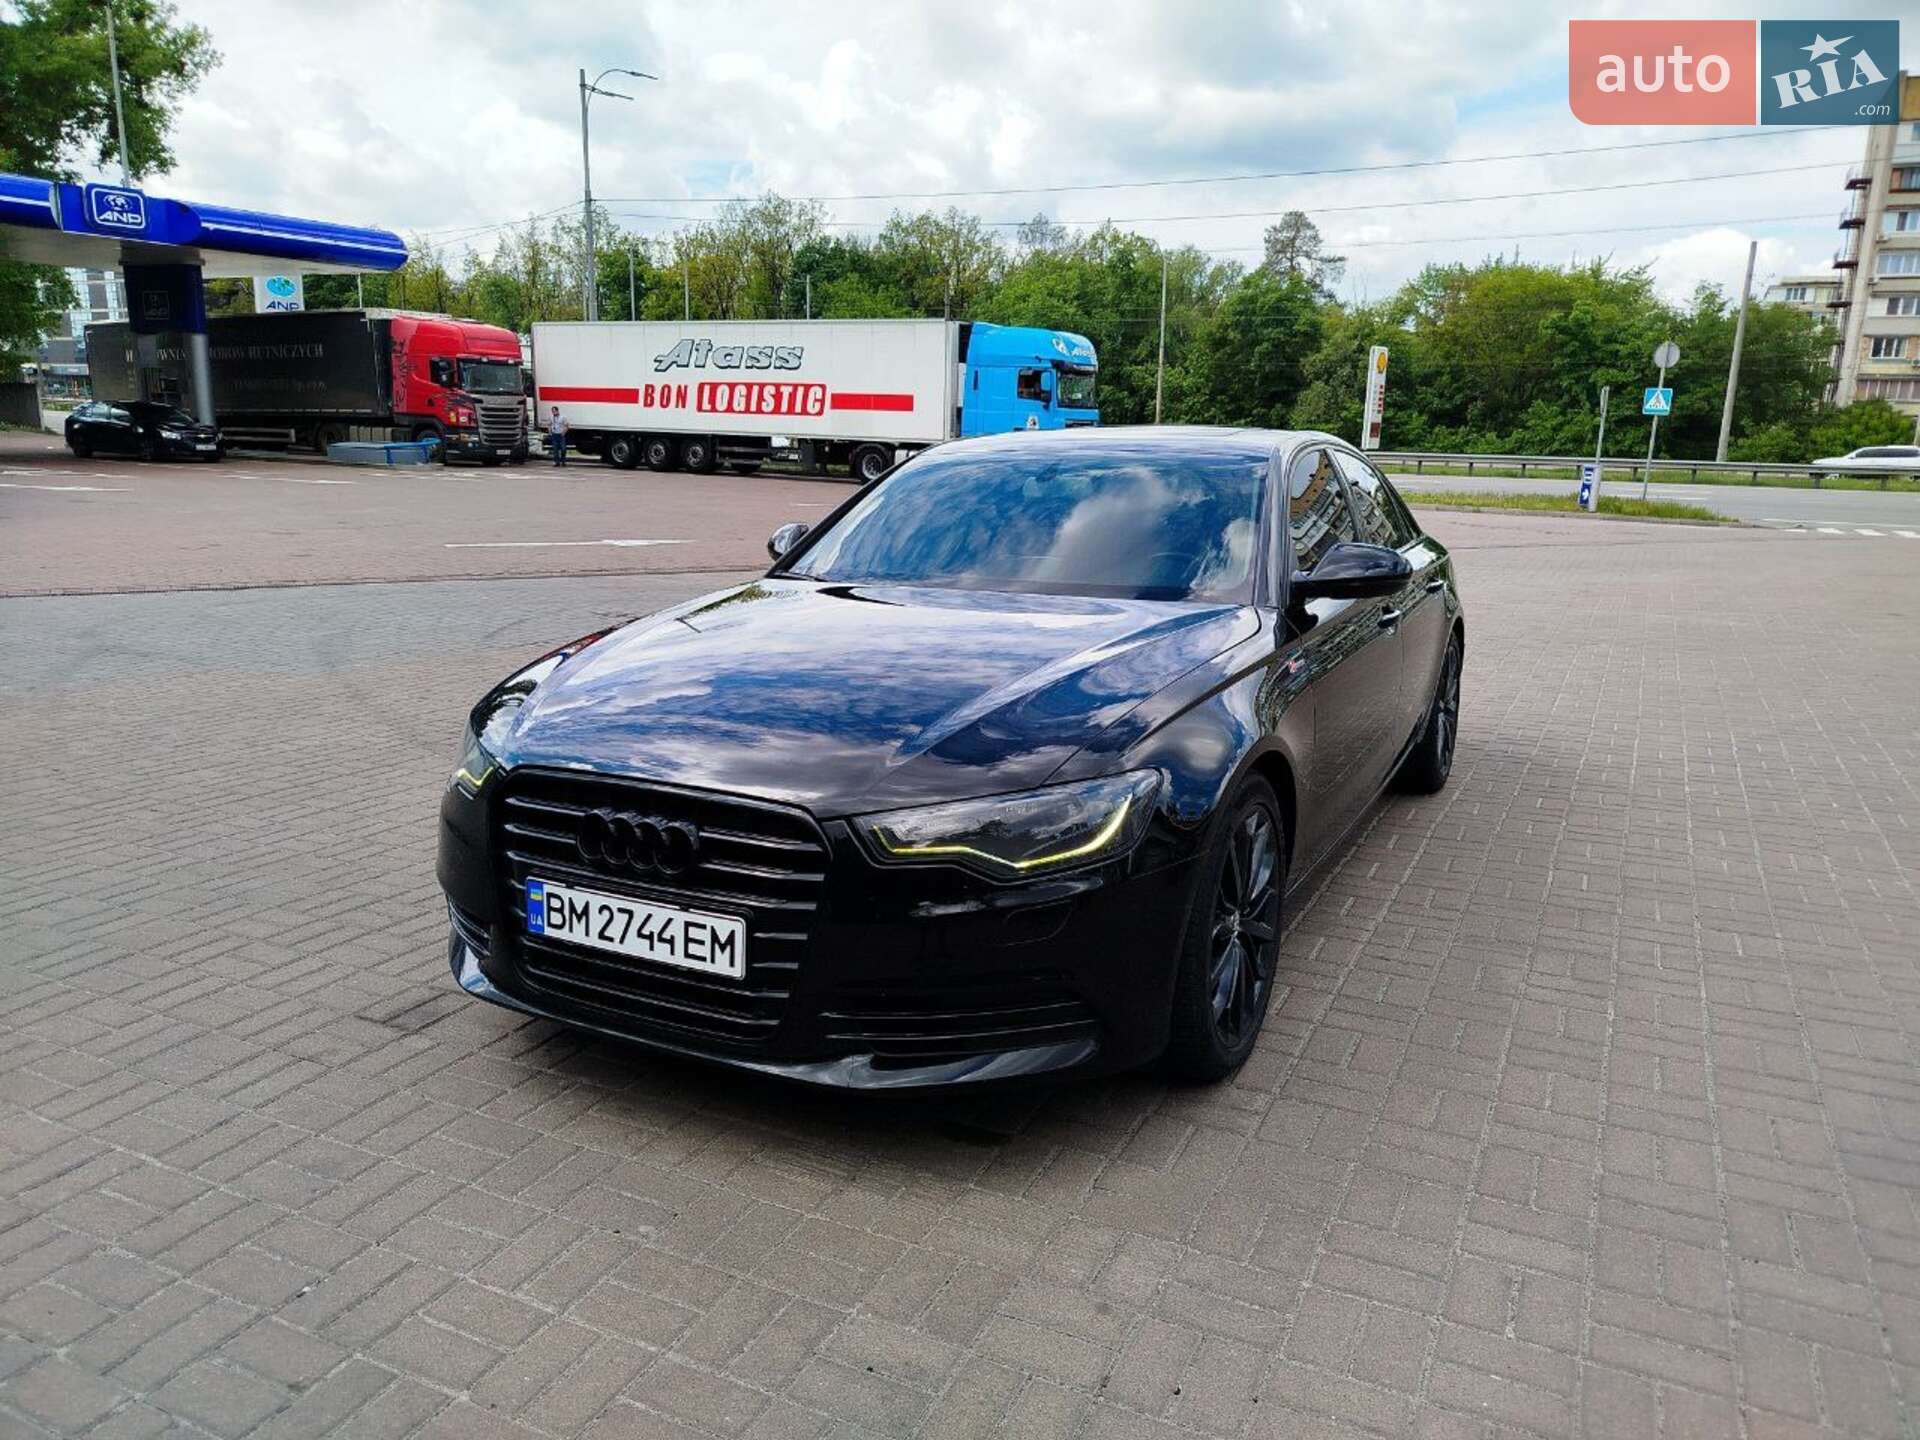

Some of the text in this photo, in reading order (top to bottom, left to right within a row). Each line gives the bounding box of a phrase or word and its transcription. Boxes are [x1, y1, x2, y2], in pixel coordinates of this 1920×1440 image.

[654, 338, 804, 373] Atass
[643, 383, 823, 415] BON LOGISTIC
[530, 914, 543, 926] UA
